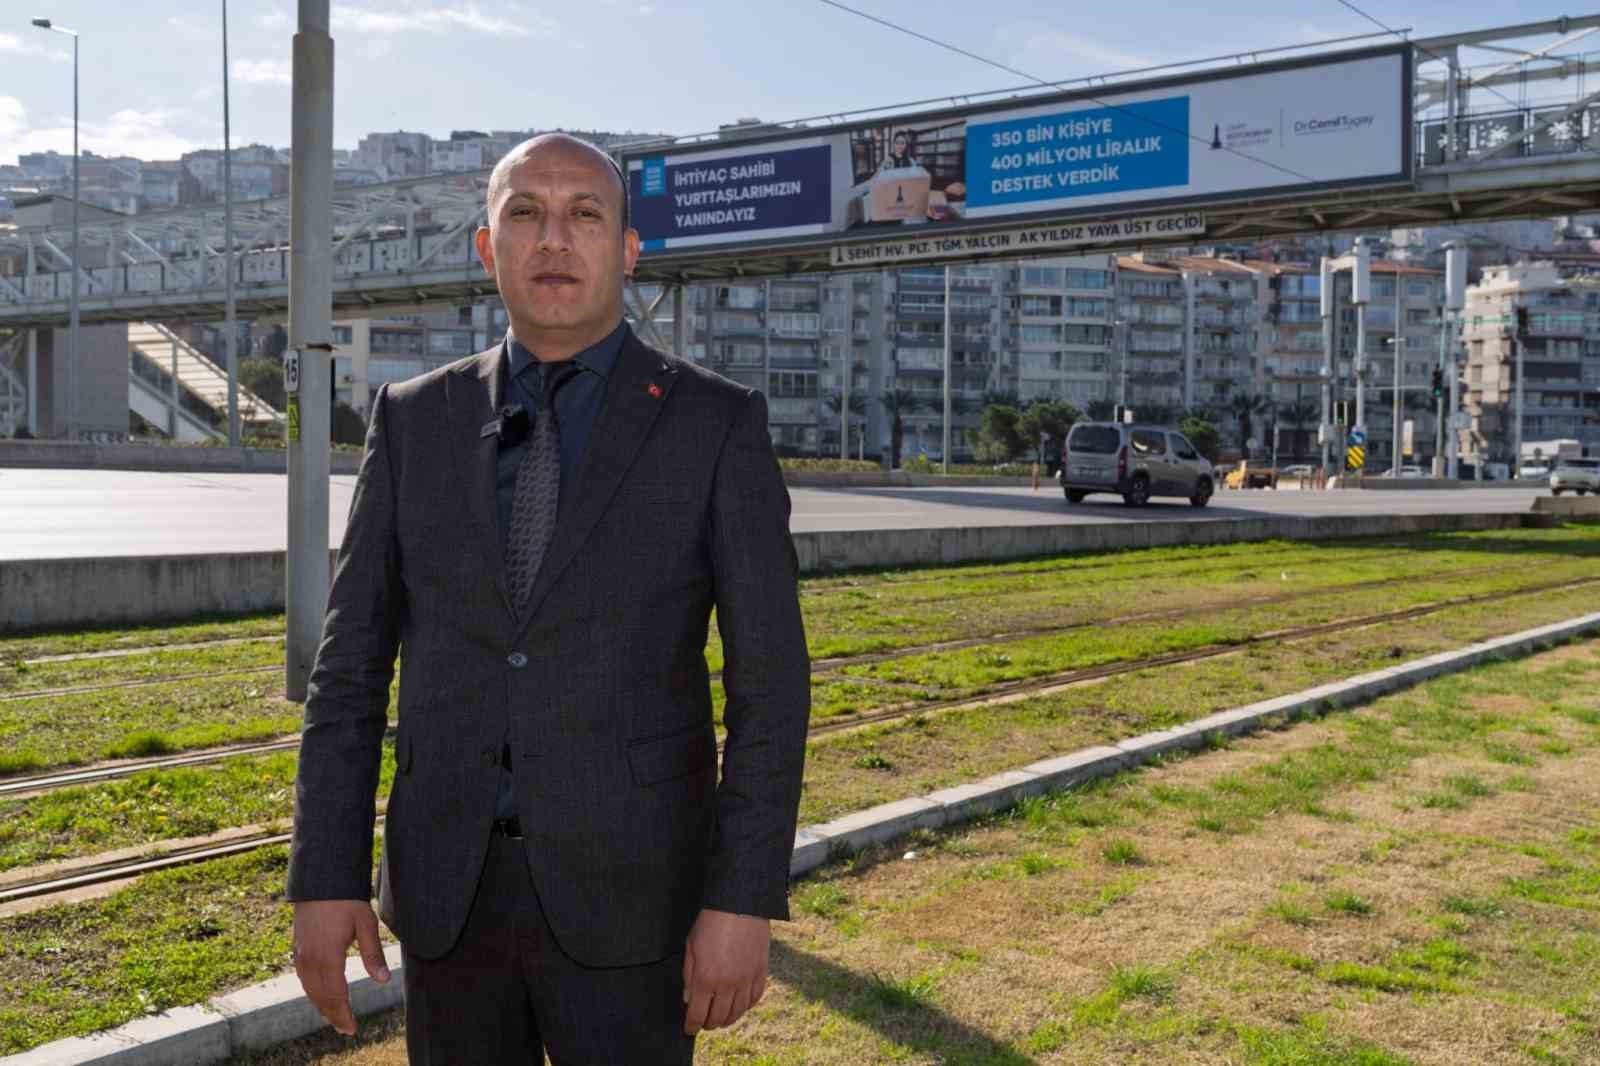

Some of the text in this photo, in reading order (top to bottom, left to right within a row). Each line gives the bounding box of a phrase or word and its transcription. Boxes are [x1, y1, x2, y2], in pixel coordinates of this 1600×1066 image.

[991, 117, 1112, 148] 350 BİN KİŞİYE
[990, 136, 1162, 171] 400 MİLYON LİRALIK
[674, 168, 727, 186] İHTİYAÇ
[730, 159, 775, 180] SAHİBİ
[991, 165, 1120, 194] DESTEK VERDİK
[674, 181, 801, 207] YURTTAŞLARIMIZIN
[675, 208, 756, 229] YANINDAYIZ
[1087, 222, 1120, 238] YAYA
